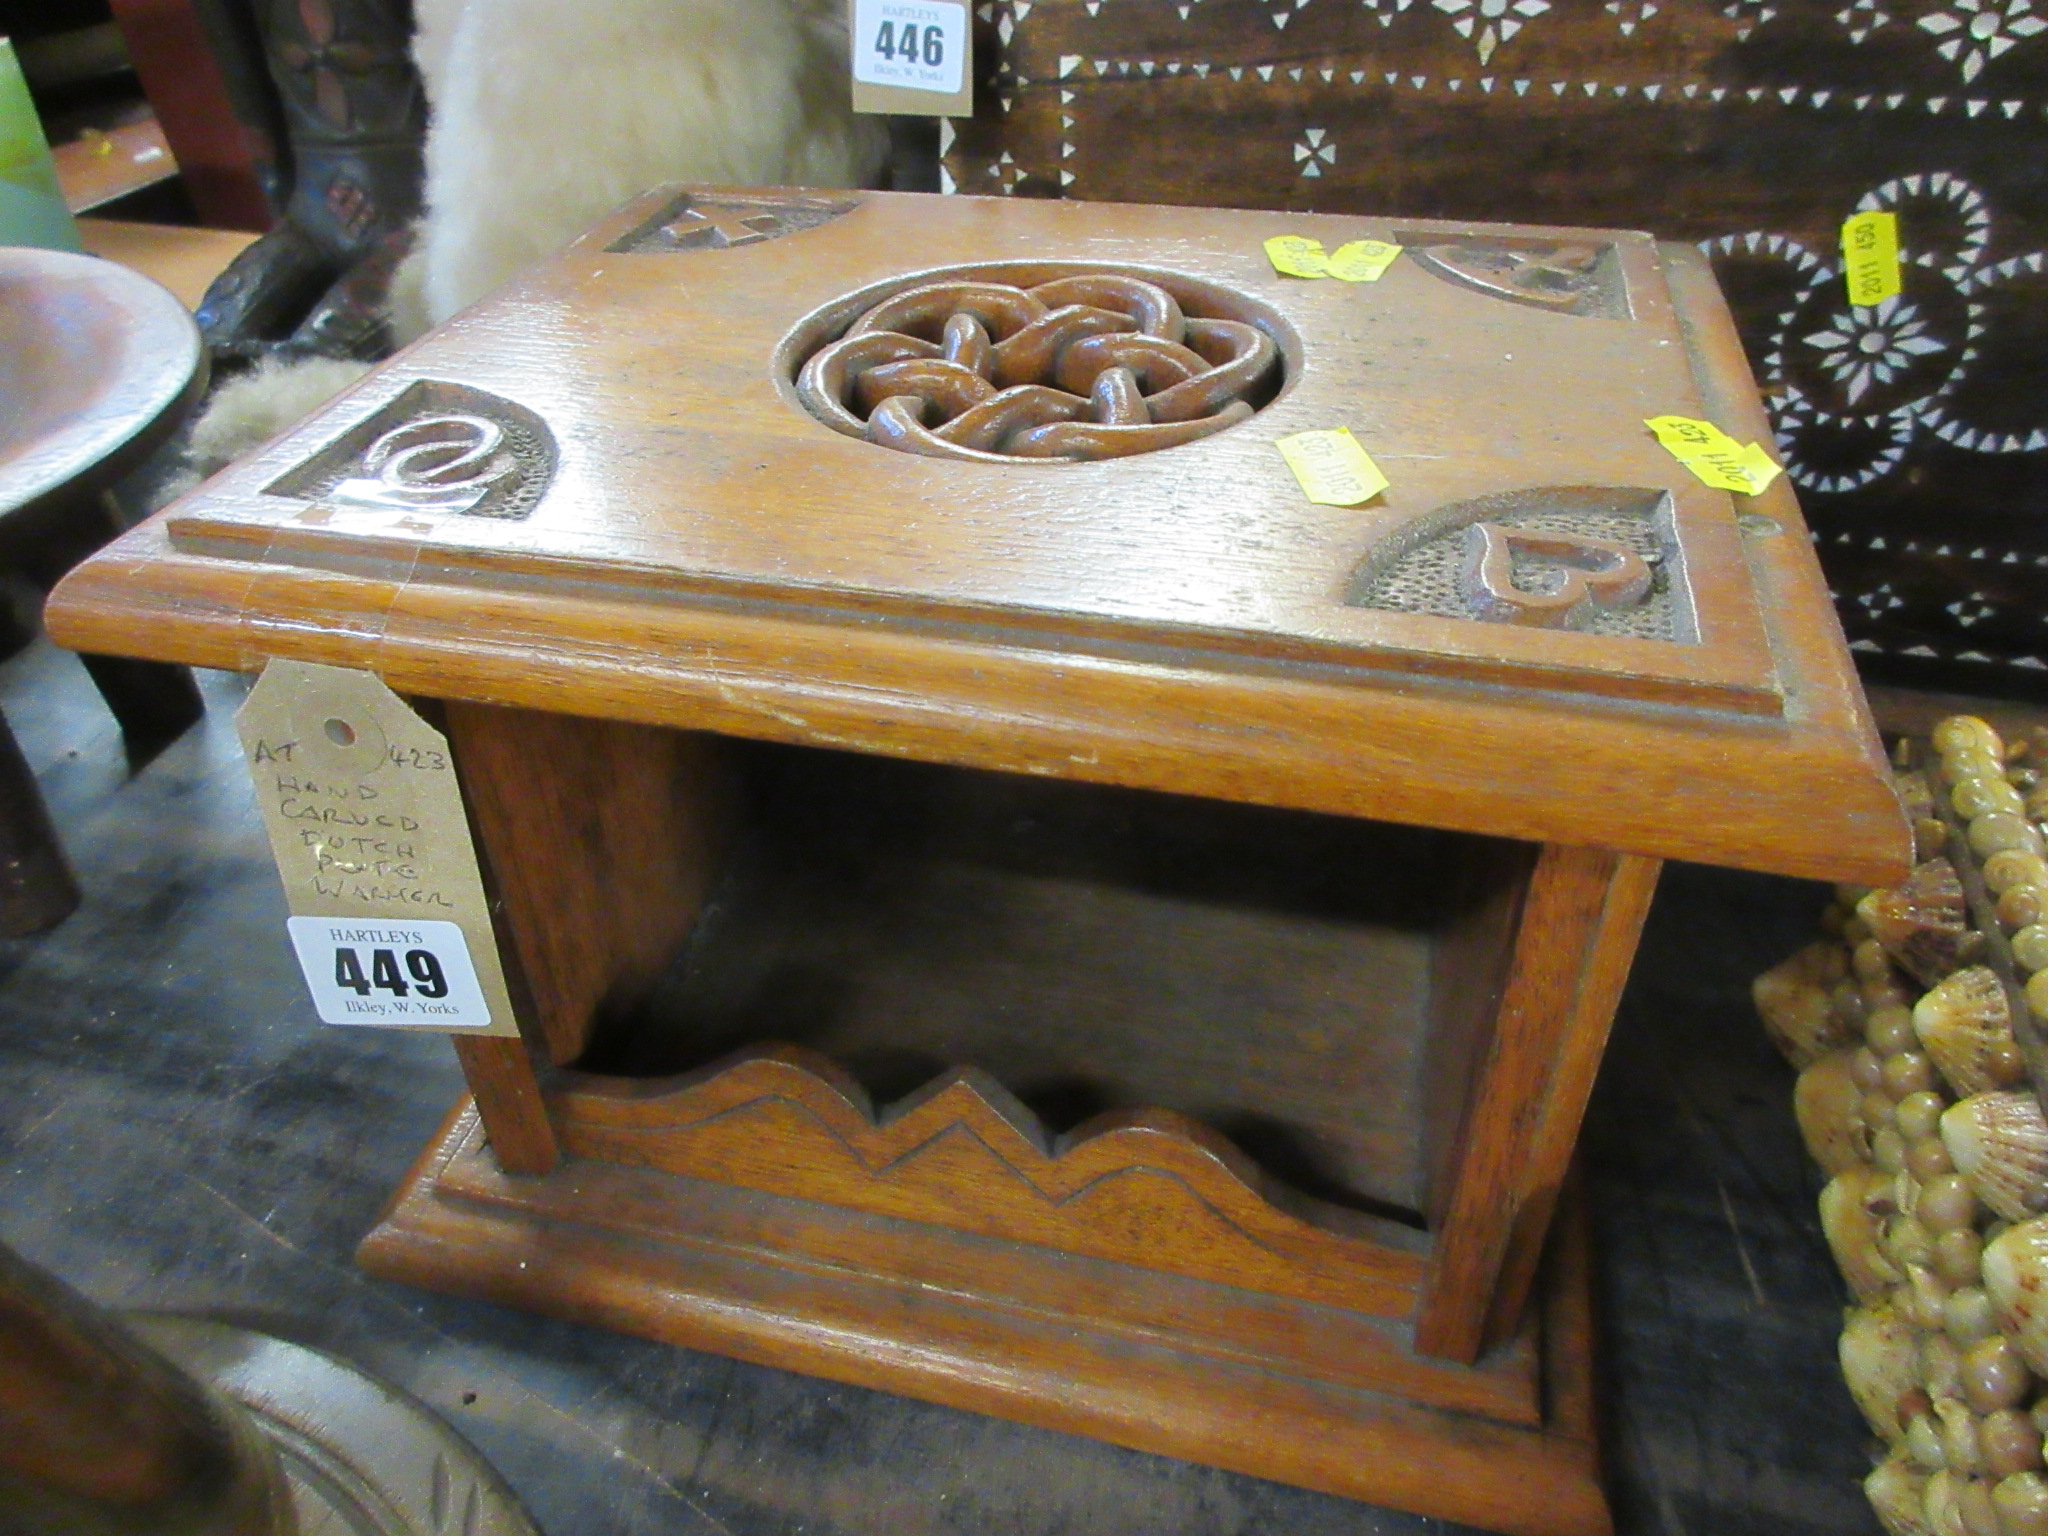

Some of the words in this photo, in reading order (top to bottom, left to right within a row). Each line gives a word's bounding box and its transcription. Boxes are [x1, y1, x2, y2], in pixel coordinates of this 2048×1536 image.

[881, 5, 940, 20] HARTLEYS
[874, 20, 944, 67] 446
[1855, 222, 1877, 250] 450
[1858, 260, 1883, 298] 2011
[1667, 421, 1711, 445] 423
[1315, 462, 1364, 496] 2011
[1701, 452, 1757, 484] 2011
[253, 738, 299, 764] AT
[389, 744, 446, 770] 423
[276, 774, 379, 801] HAND
[300, 828, 415, 859] DUTCH
[310, 875, 454, 908] WARMER
[329, 928, 424, 944] HARTLEYS
[335, 947, 450, 999] 449
[345, 1000, 392, 1016] Ilkley,
[393, 1001, 415, 1014] W.
[416, 1002, 460, 1015] Yorks
